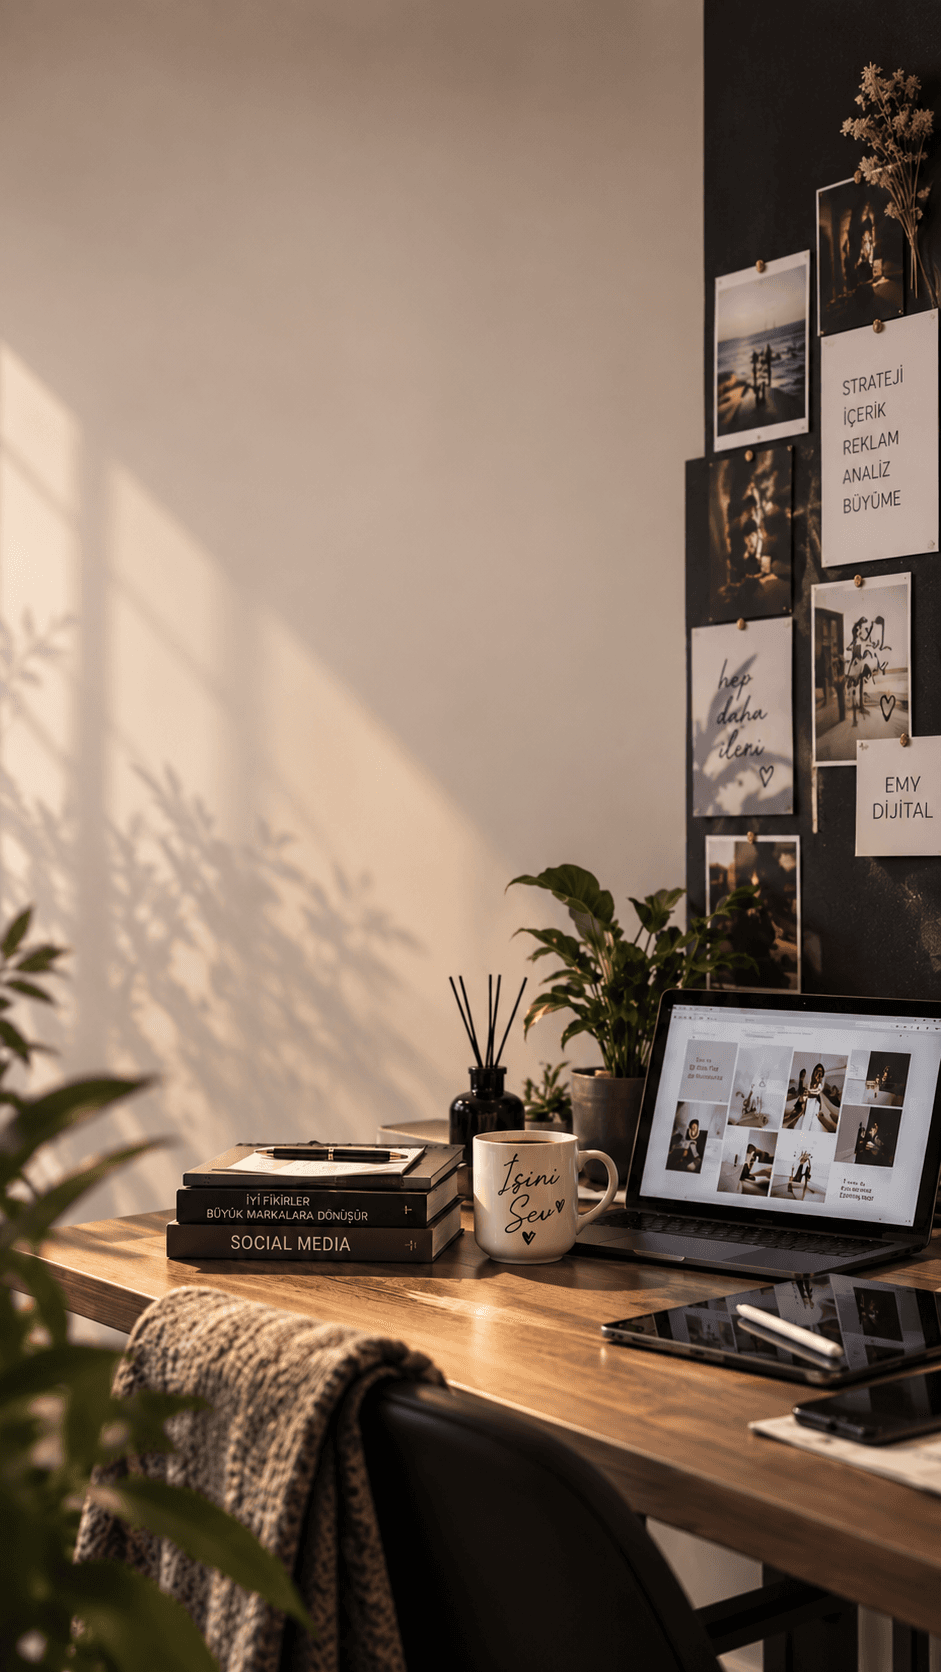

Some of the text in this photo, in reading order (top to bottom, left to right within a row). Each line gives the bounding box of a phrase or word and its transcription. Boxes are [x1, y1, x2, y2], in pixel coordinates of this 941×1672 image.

[842, 364, 904, 396] STRATEJİ
[843, 401, 887, 428] İÇERİK
[843, 430, 900, 456] REKLAM
[842, 459, 891, 485] ANALİZ
[843, 489, 902, 515] BÜYÜME
[718, 658, 753, 701] hep
[716, 695, 768, 725] daha
[718, 729, 765, 760] ileri
[885, 776, 922, 794] EMY
[872, 800, 934, 820] DİJİTAL
[246, 1193, 310, 1207] İYİ FİKİRLER
[246, 1209, 314, 1220] MARKALARA
[230, 1235, 351, 1252] SOCIAL MEDIA
